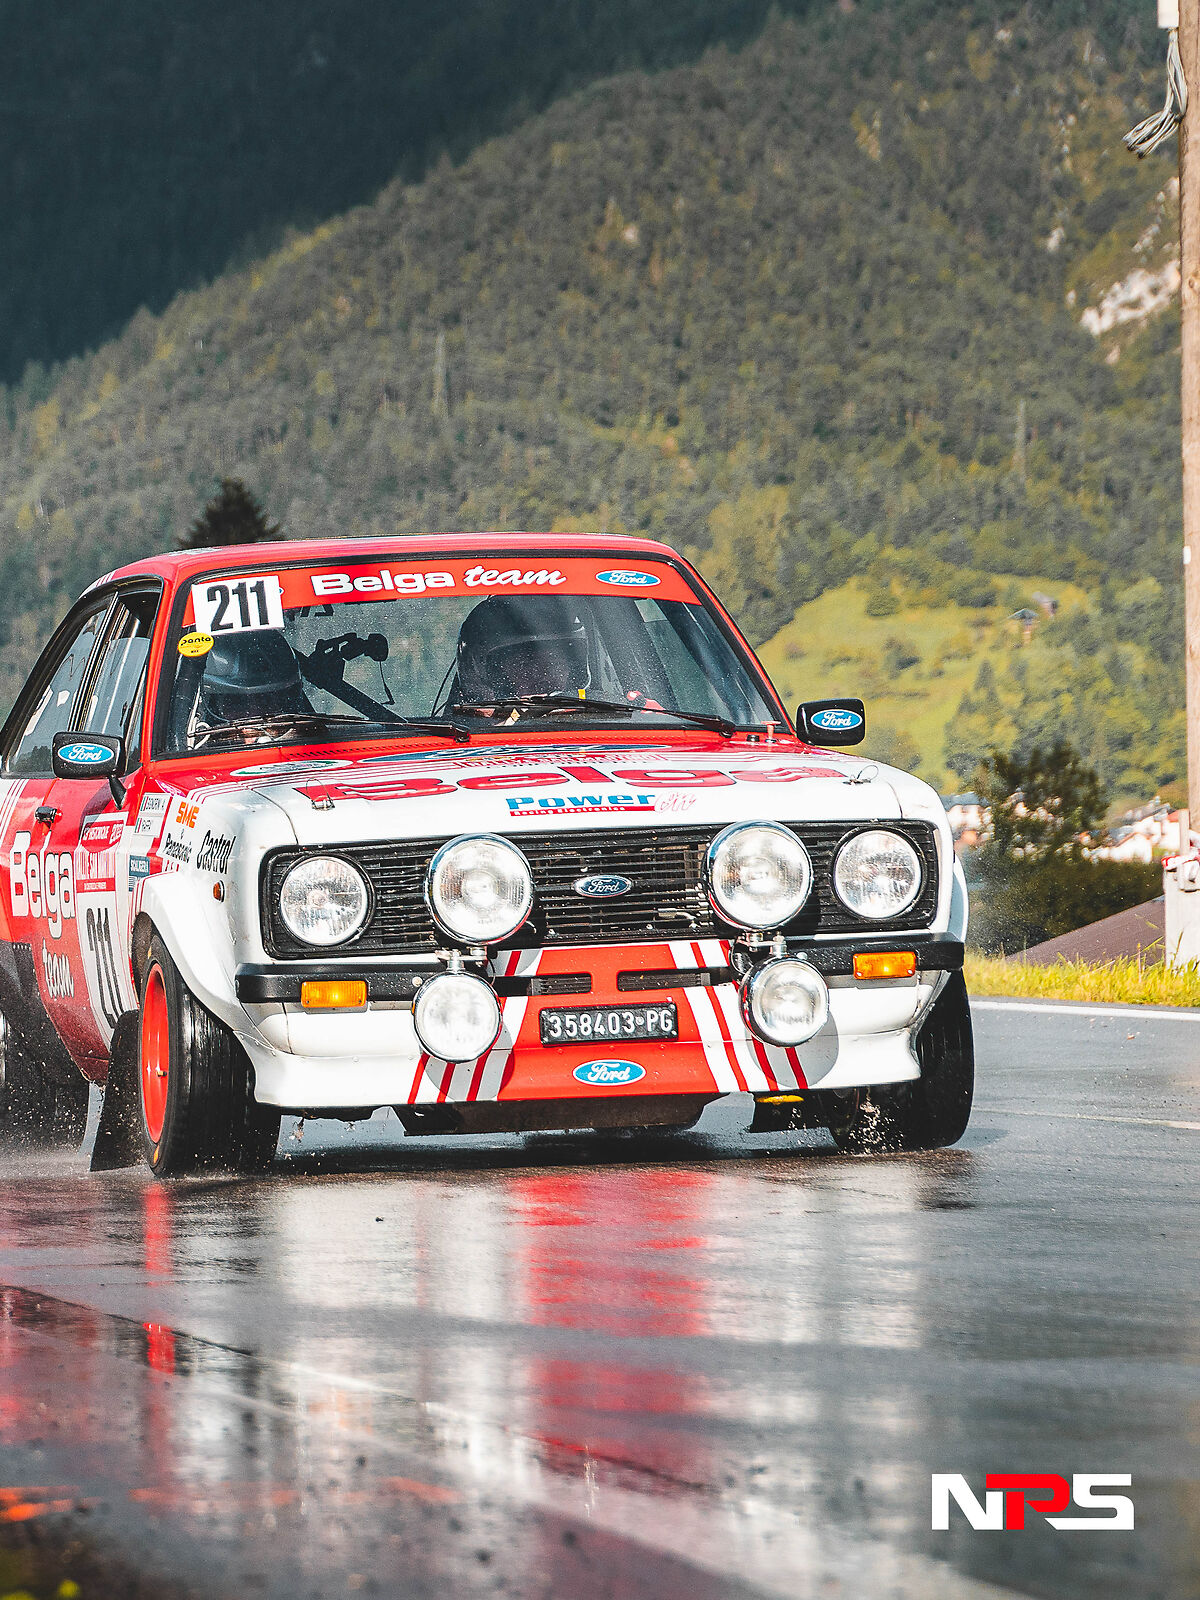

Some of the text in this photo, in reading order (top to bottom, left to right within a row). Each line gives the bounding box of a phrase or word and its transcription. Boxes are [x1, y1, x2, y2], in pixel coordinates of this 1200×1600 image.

[310, 565, 567, 596] Belga team
[607, 571, 646, 586] Ford
[207, 580, 269, 632] 211
[821, 711, 852, 726] Ford
[68, 745, 104, 760] Ford
[292, 767, 849, 801] Belga
[176, 801, 199, 828] SME
[506, 794, 655, 809] Power
[196, 830, 236, 874] Castrol
[10, 831, 75, 938] Belga
[588, 875, 621, 893] Ford
[42, 938, 74, 998] team
[86, 907, 126, 1028] 211
[587, 1061, 631, 1084] Ford
